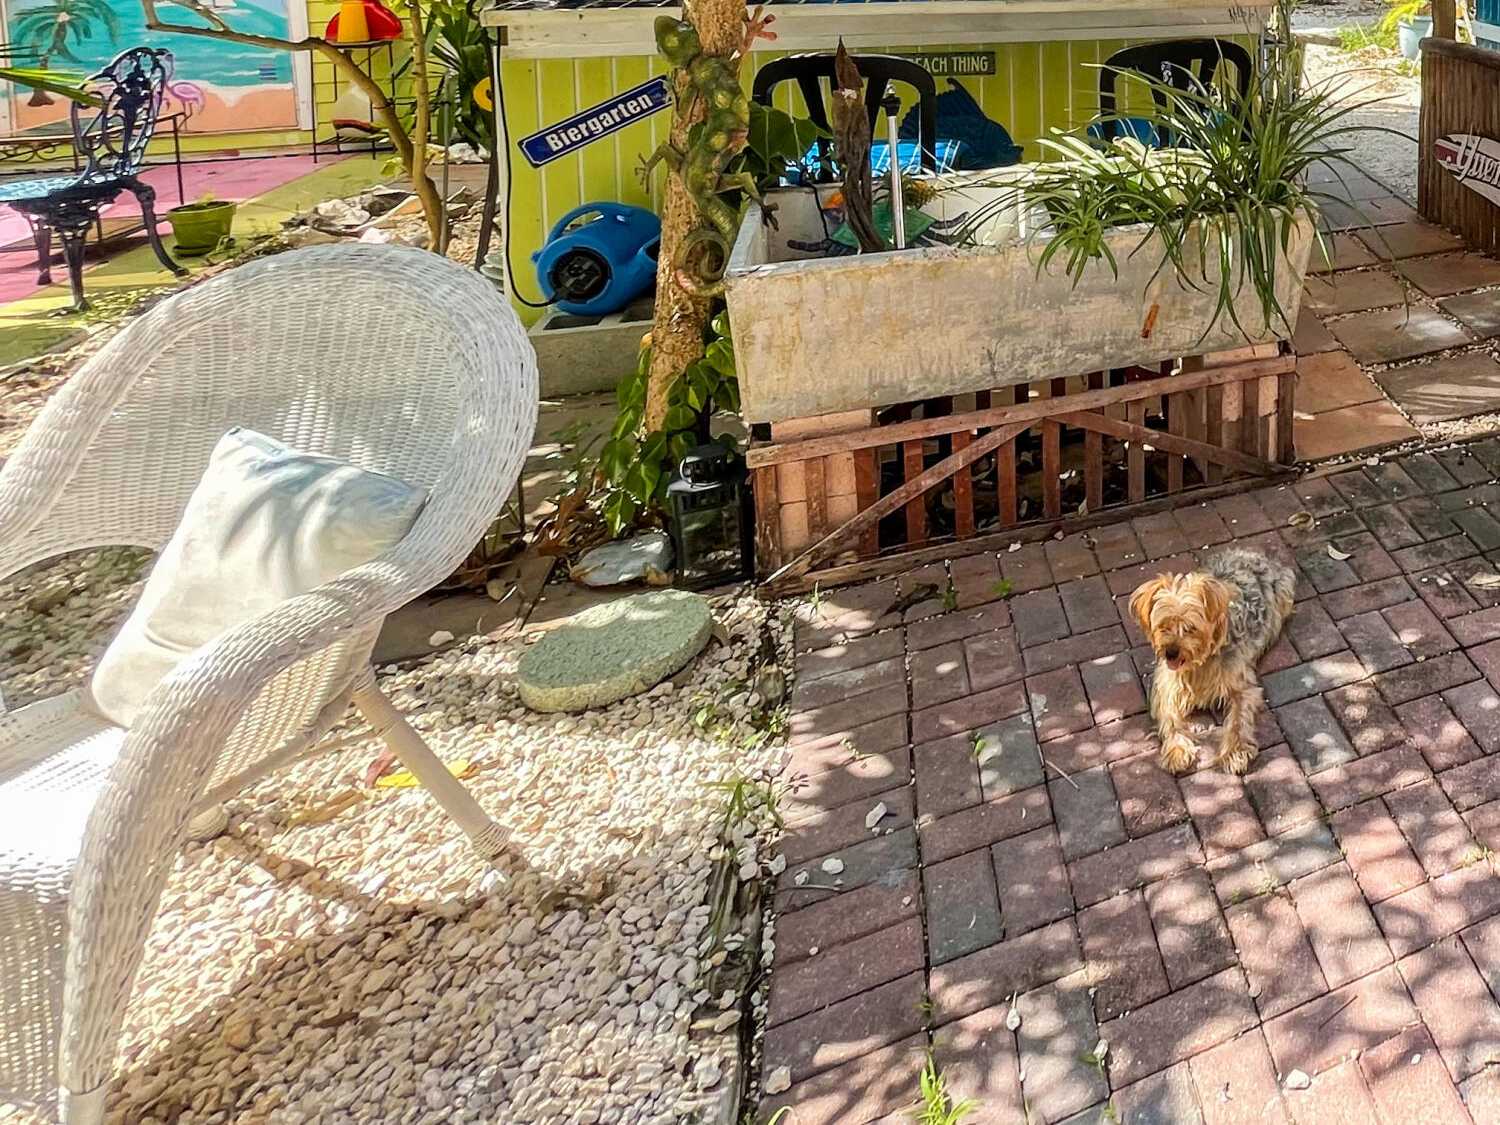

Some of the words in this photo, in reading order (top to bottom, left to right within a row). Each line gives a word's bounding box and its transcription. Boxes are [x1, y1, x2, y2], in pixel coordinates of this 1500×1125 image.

[910, 57, 948, 73] ACH
[951, 56, 989, 73] THING
[545, 94, 653, 152] Biergarten
